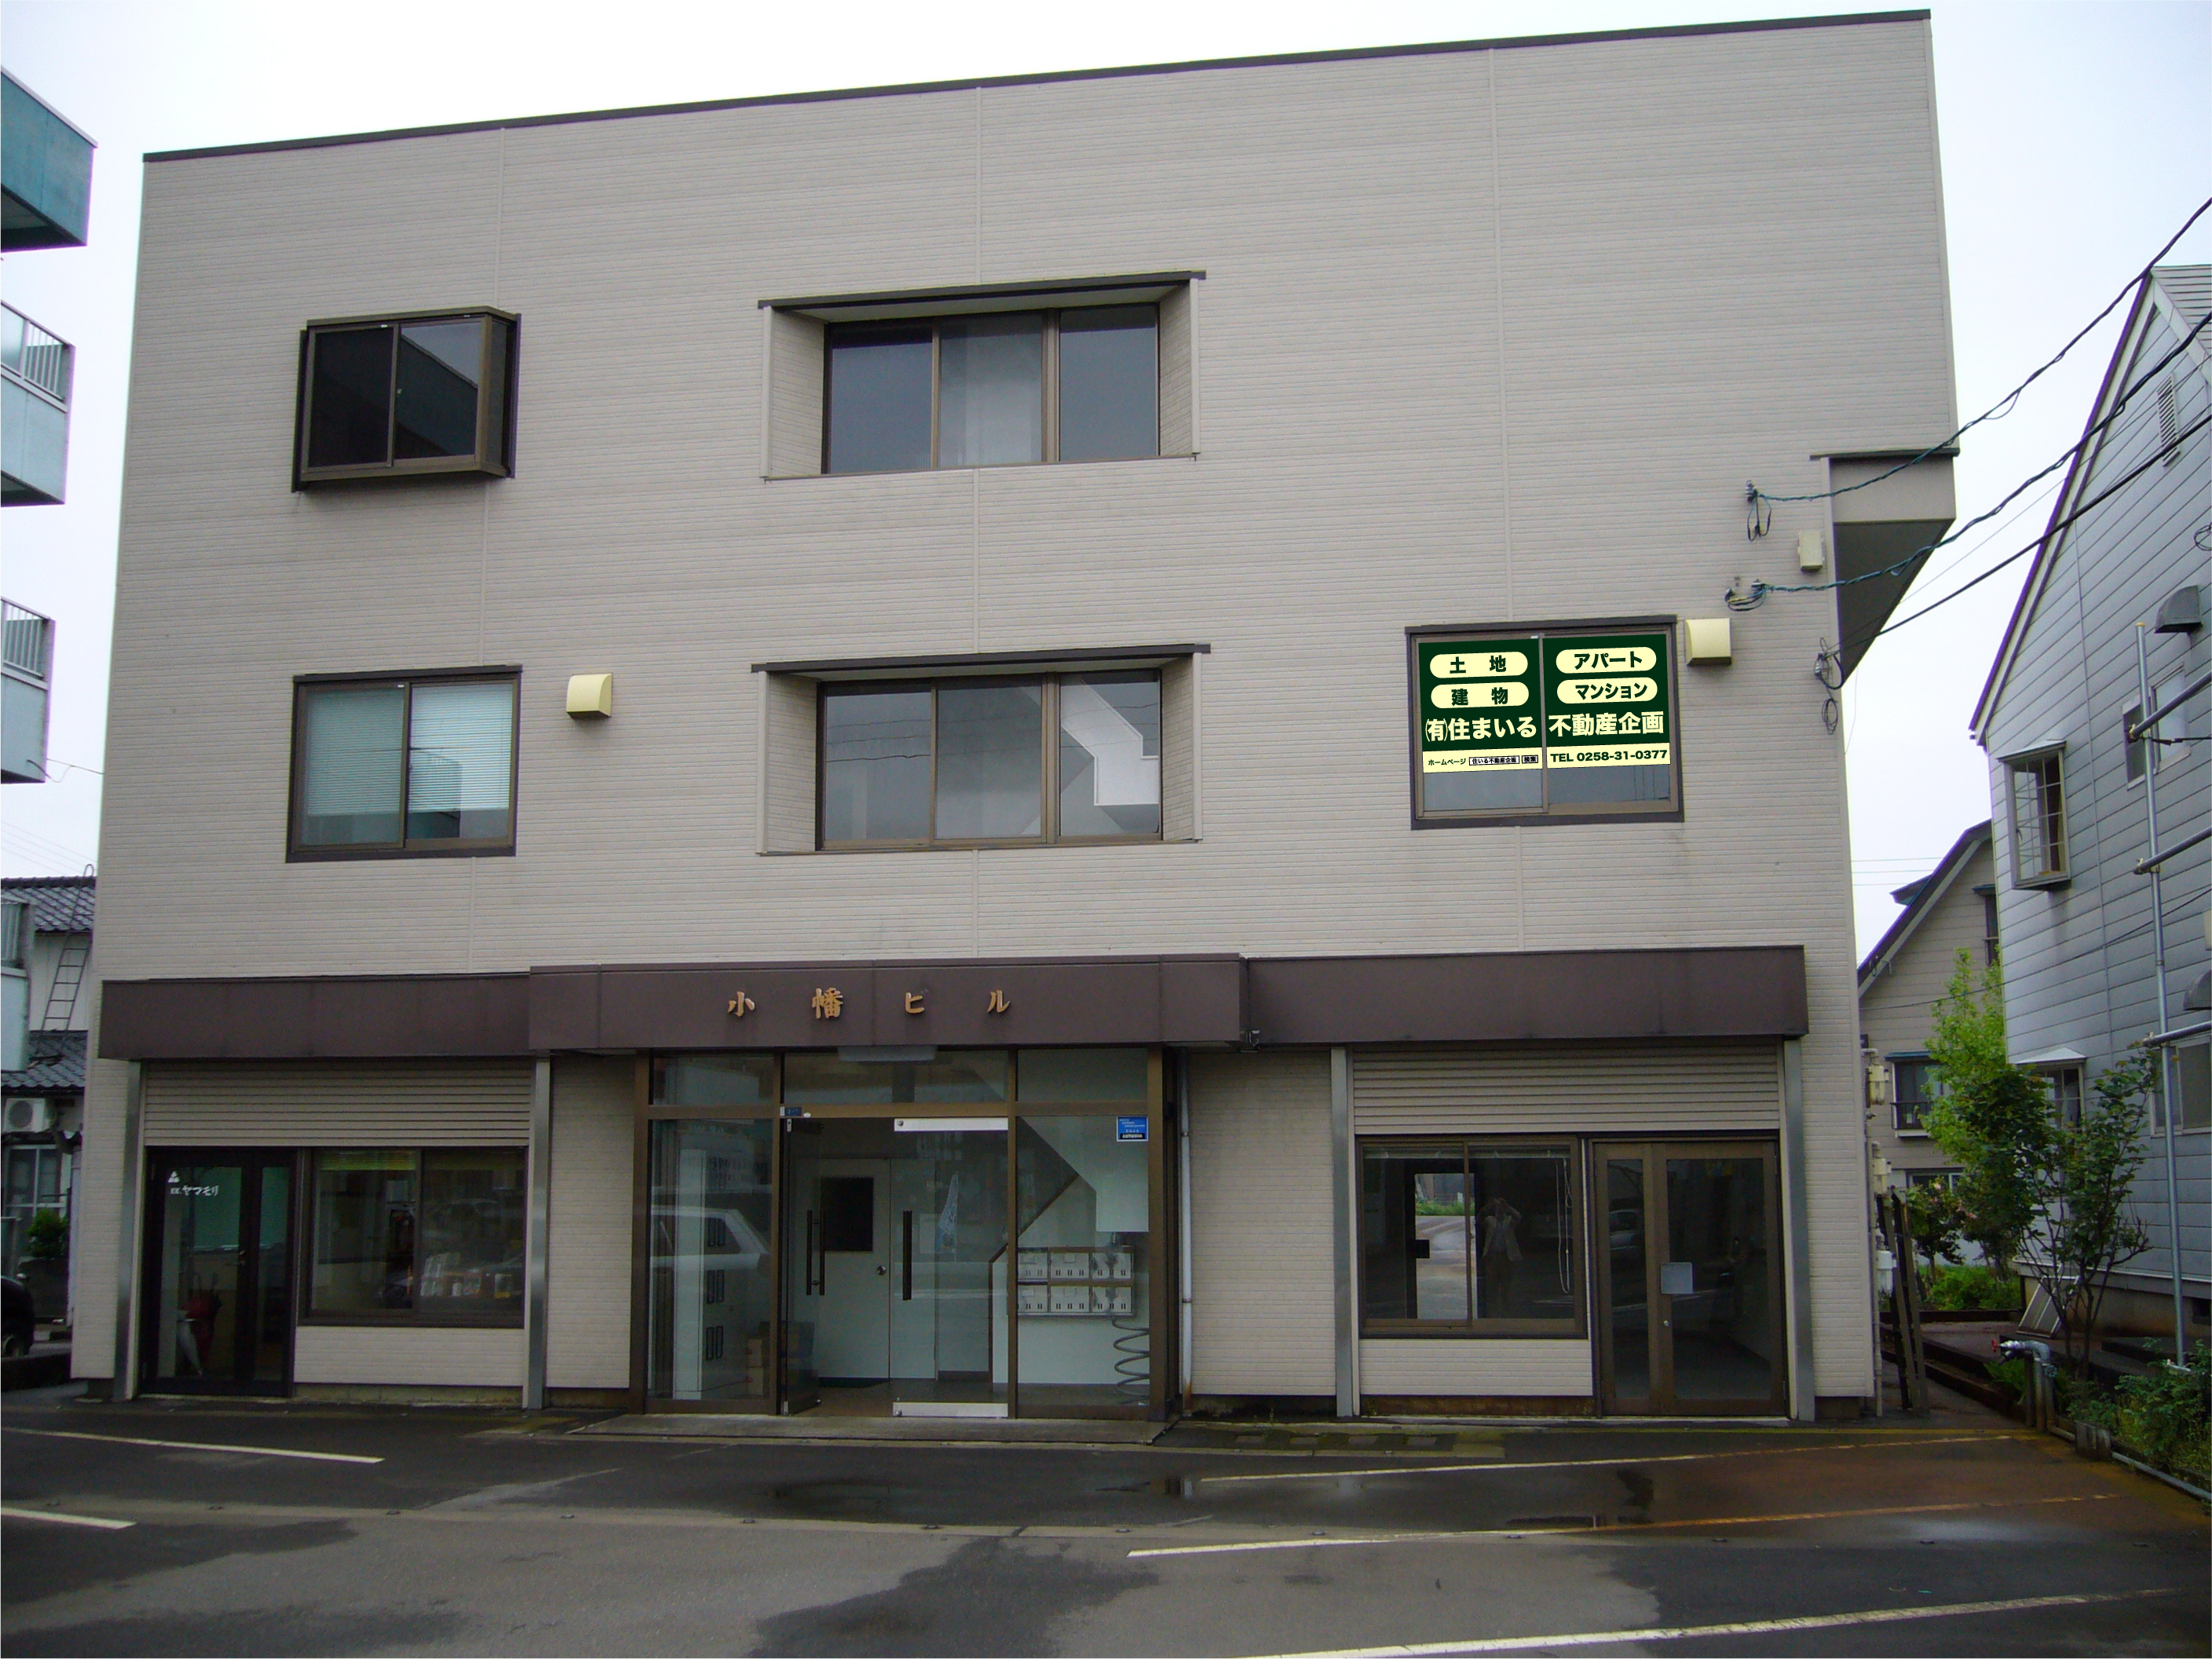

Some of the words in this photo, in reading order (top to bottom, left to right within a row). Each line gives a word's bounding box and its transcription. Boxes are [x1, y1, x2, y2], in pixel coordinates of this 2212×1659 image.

[1574, 652, 1643, 670] アパート
[1575, 682, 1647, 700] マンション
[1428, 758, 1467, 766] ホームページ
[1550, 753, 1574, 762] TEL
[1576, 749, 1668, 762] 0258-31-0377
